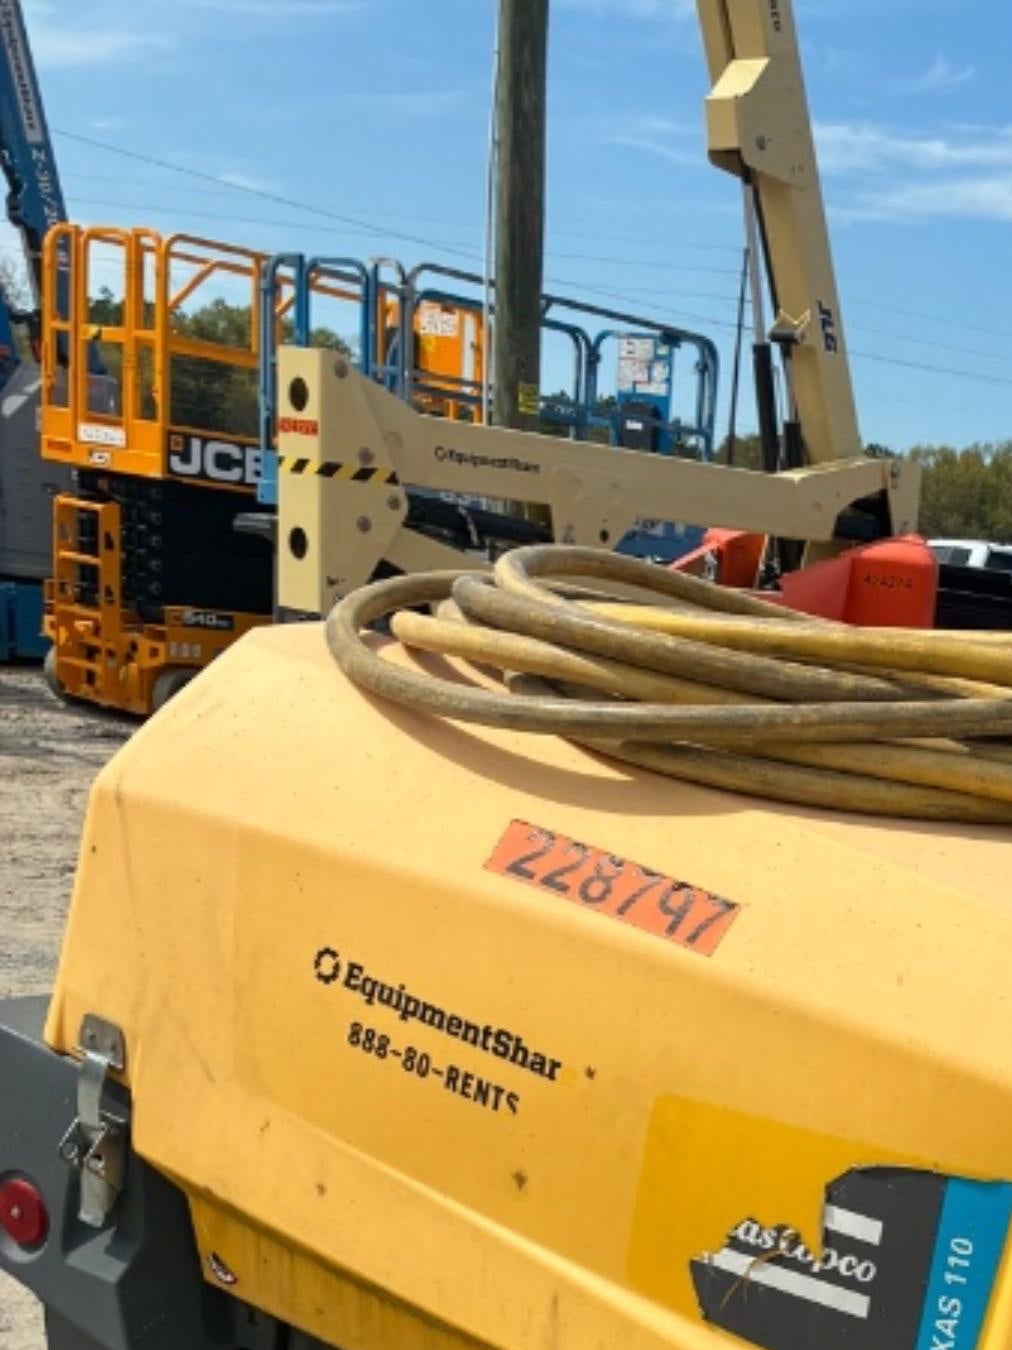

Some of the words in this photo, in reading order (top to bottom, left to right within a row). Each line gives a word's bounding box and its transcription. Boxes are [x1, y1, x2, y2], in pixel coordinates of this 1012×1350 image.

[505, 827, 741, 947] 228797
[347, 1021, 520, 1117] 888-80-RENTS
[945, 1236, 974, 1287] 110
